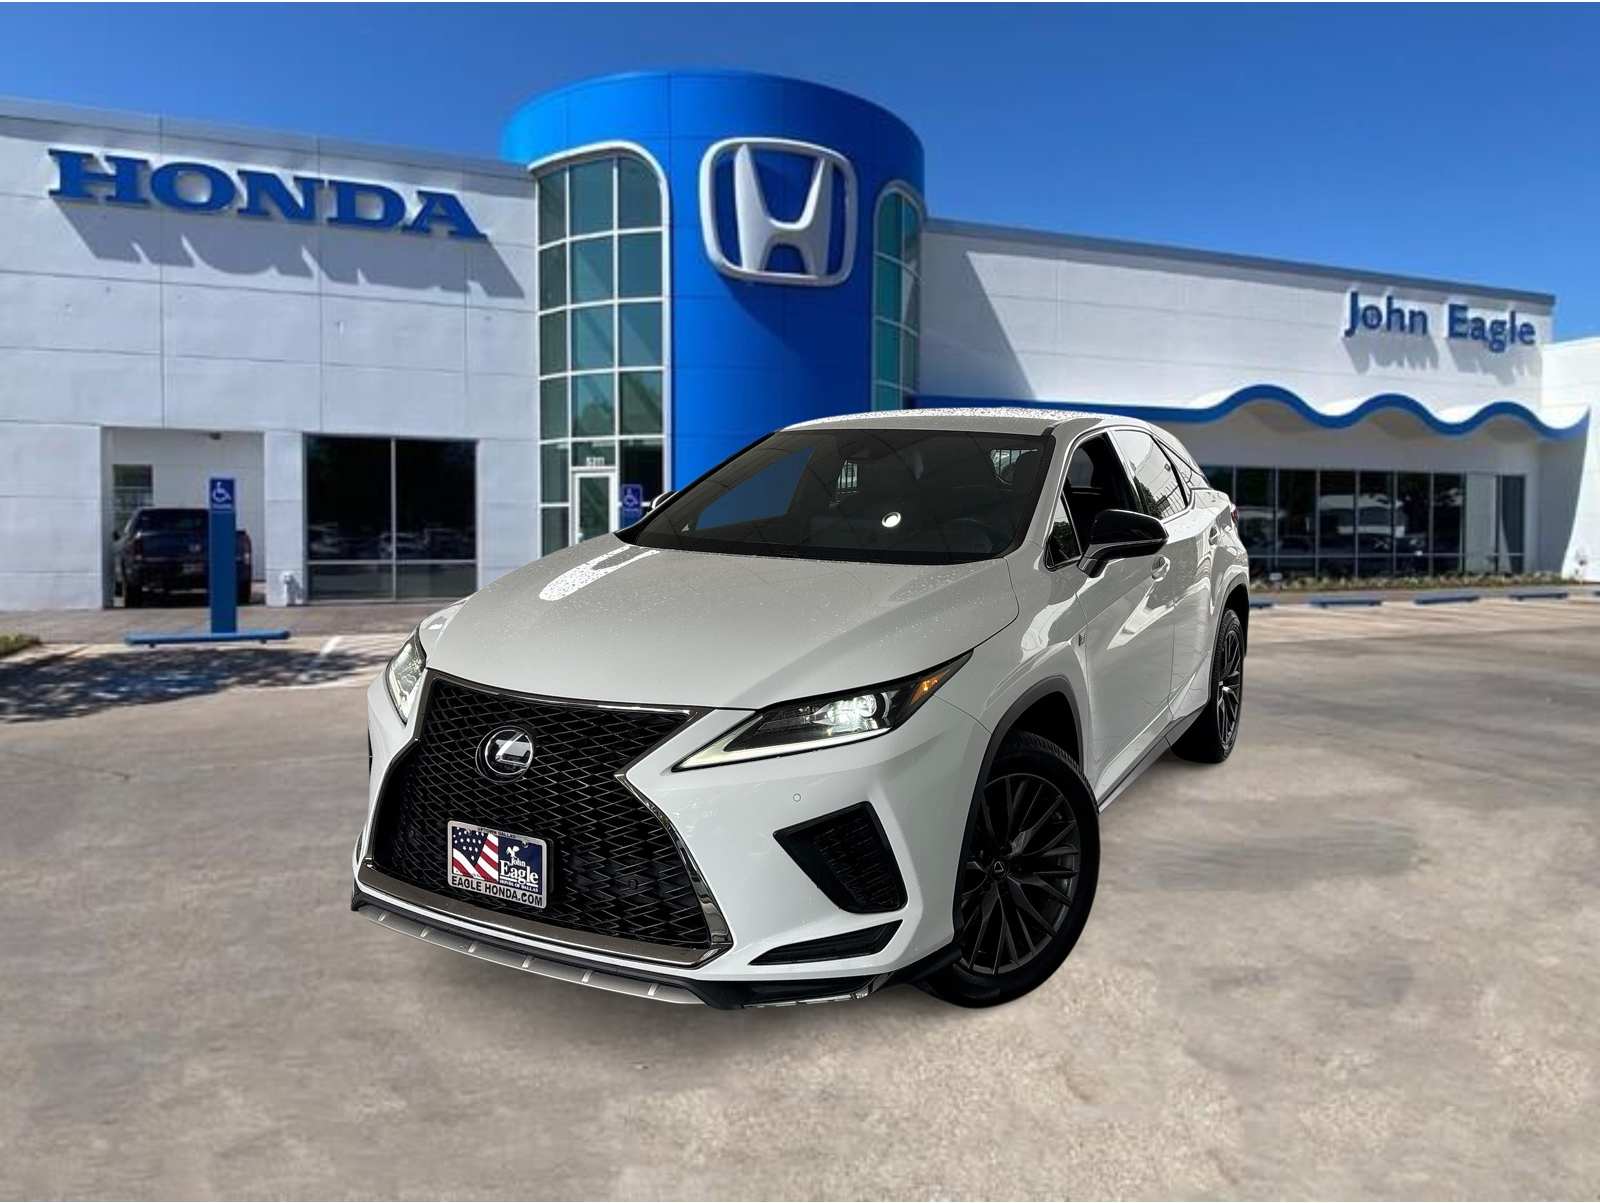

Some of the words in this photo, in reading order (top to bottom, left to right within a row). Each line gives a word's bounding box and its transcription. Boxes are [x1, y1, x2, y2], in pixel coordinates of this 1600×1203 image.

[47, 147, 489, 241] HONDA
[1344, 291, 1429, 338] John
[1448, 303, 1536, 353] Eagle
[451, 875, 482, 891] EAGLE
[485, 883, 543, 907] HONDA.COM
[500, 860, 539, 885] Eagle
